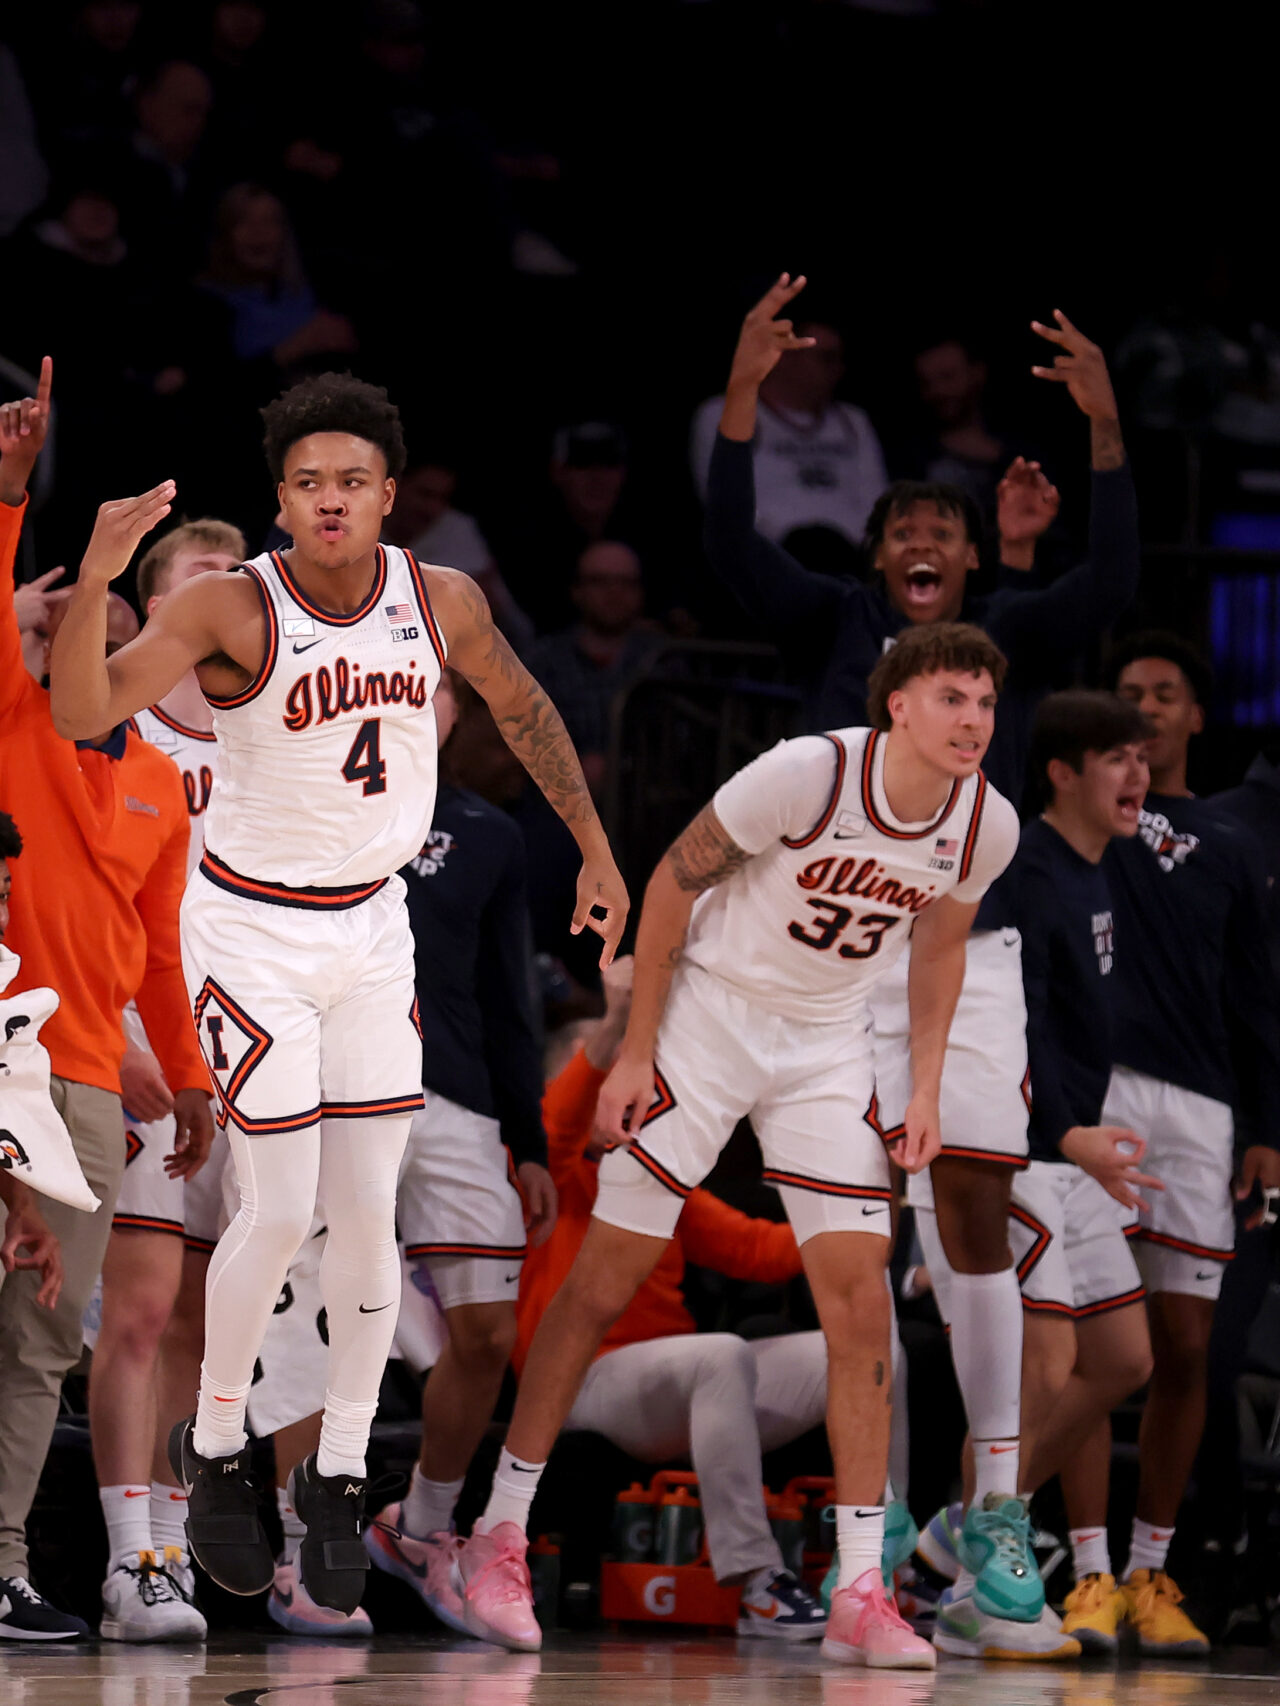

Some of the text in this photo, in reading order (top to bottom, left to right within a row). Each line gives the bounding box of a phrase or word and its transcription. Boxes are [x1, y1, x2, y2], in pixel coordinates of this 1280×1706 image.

[282, 656, 427, 732] Illinois
[340, 717, 387, 798] 4
[796, 856, 937, 913] Illinoi
[787, 897, 901, 959] 33
[644, 1576, 677, 1616] G
